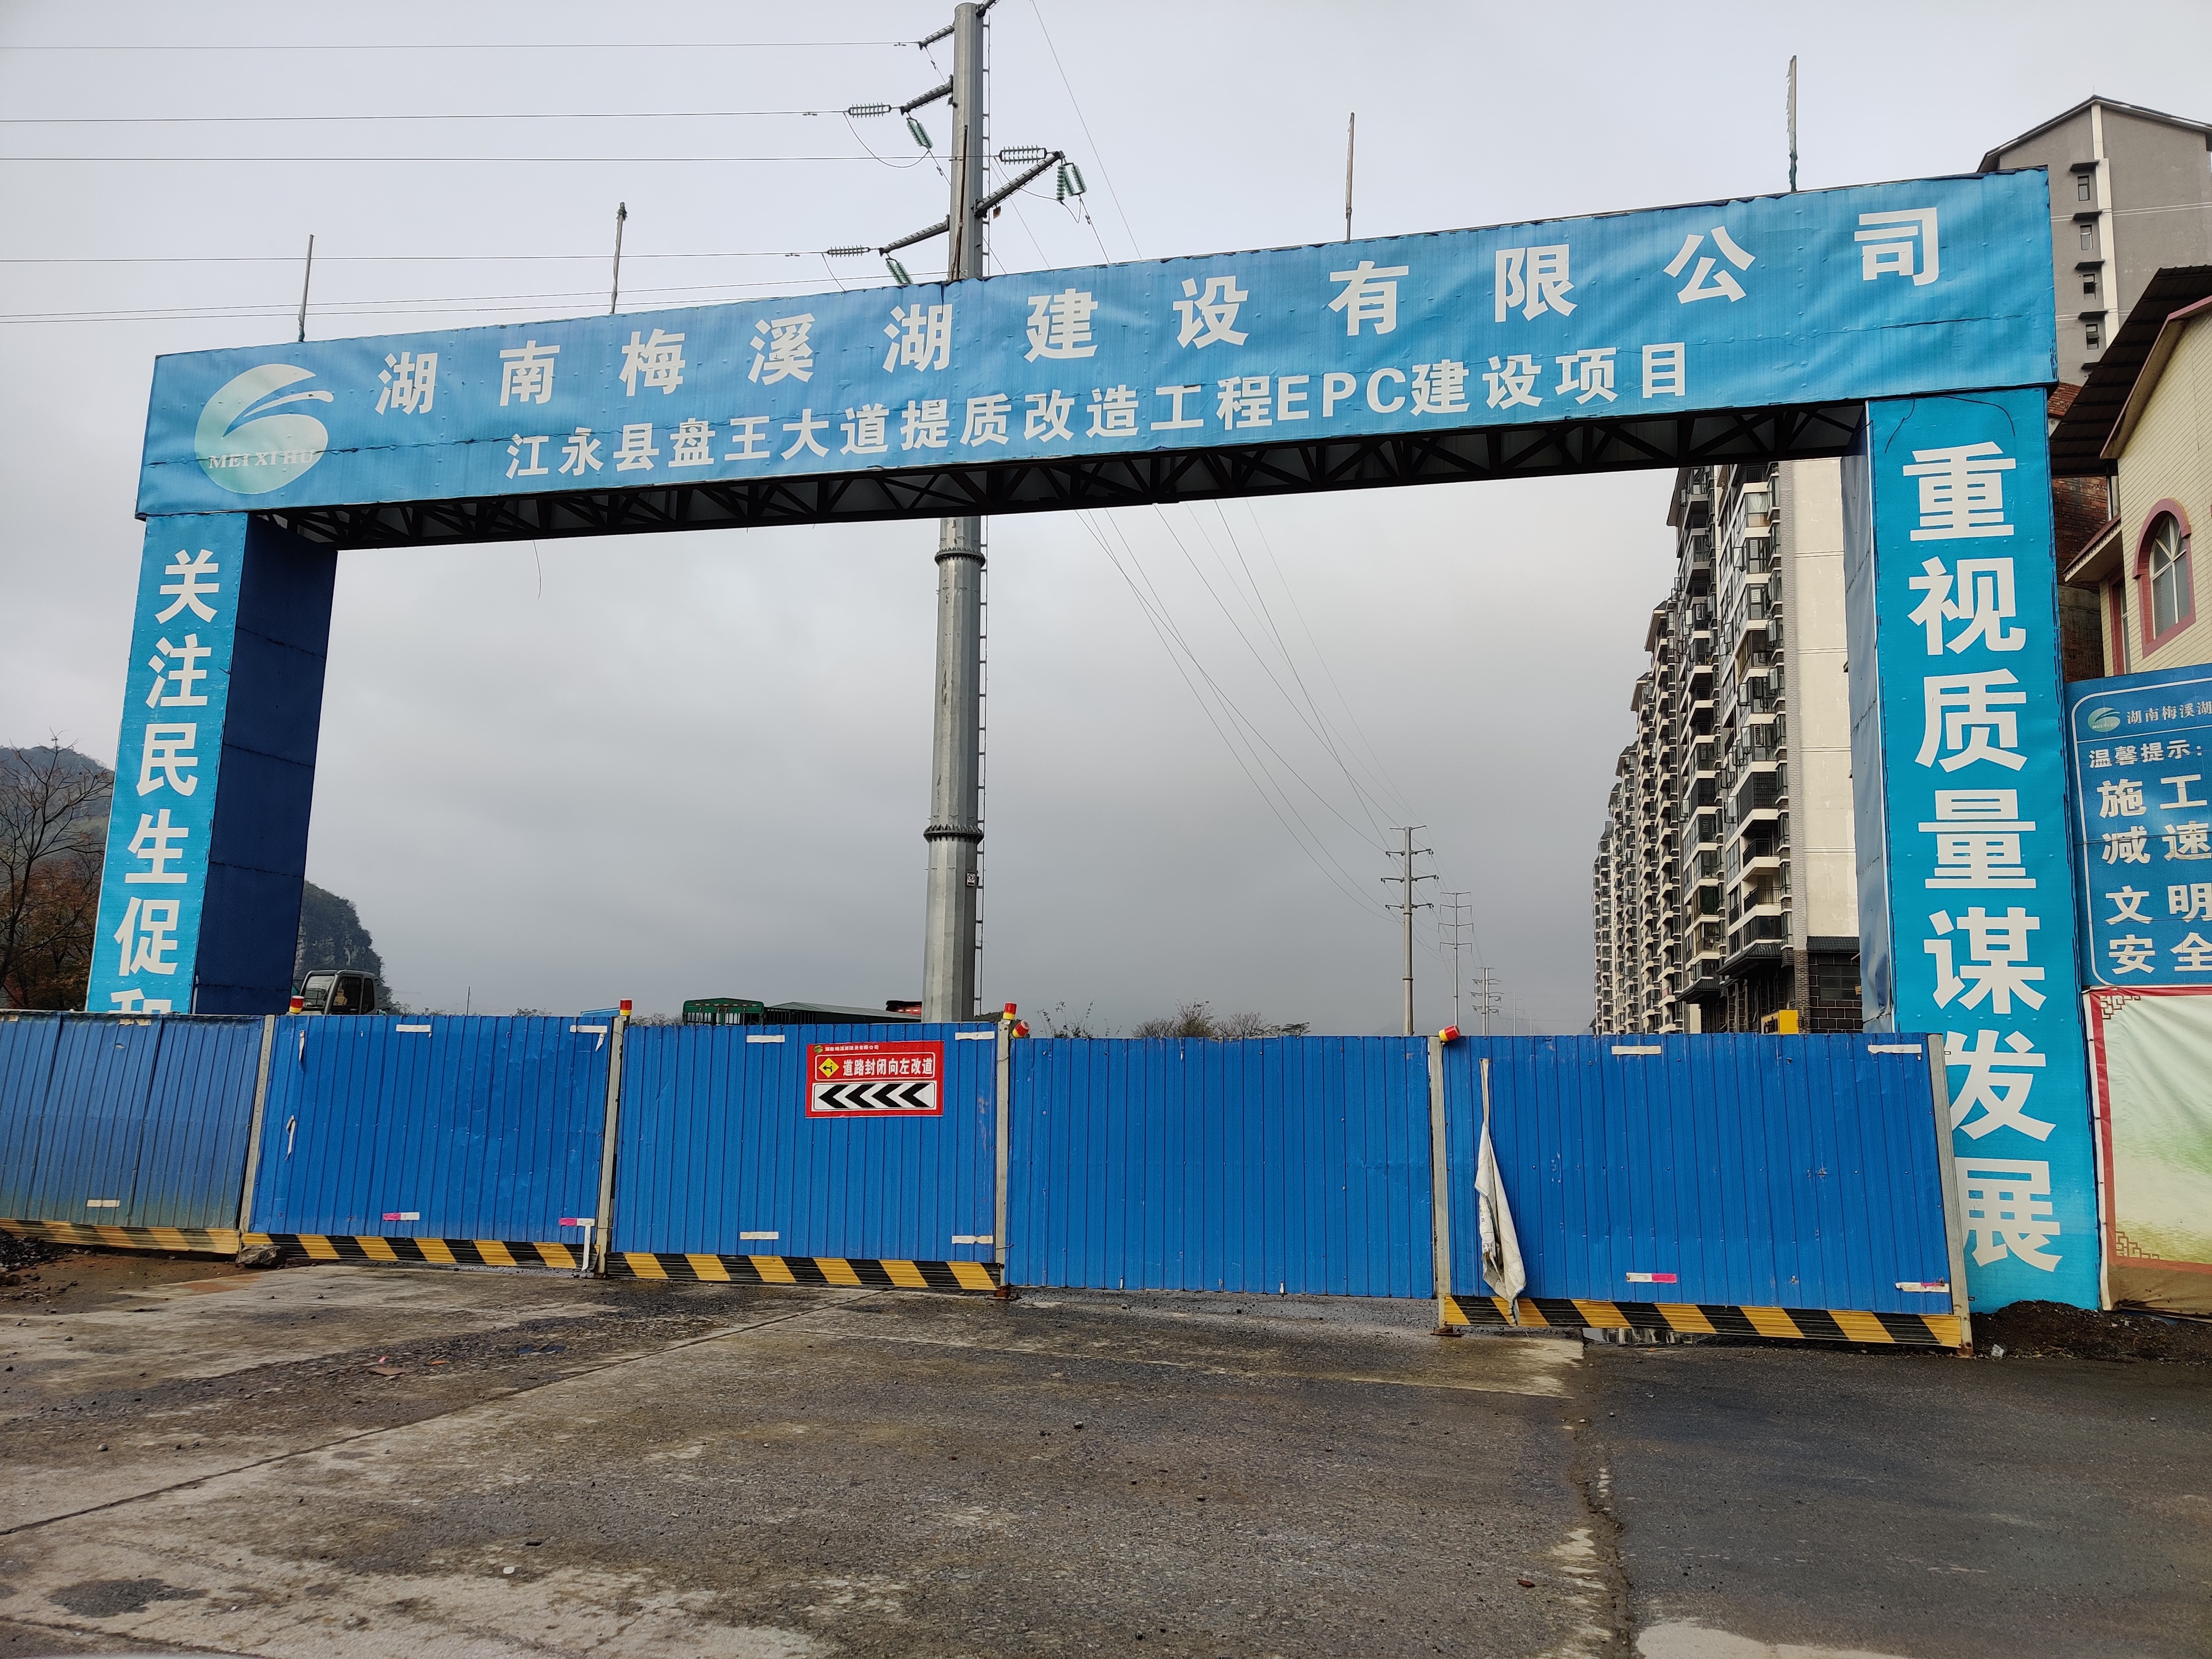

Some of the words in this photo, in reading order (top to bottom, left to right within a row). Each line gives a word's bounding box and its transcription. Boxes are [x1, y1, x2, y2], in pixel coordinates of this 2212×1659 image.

[375, 207, 1939, 415] 湖南梅溪湖建设有限公司
[505, 342, 1686, 479] 江永县盘王大道提质改造工程EPC建设项目
[208, 453, 251, 468] MEI
[2126, 701, 2212, 724] 湖南梅溪湖
[2096, 774, 2208, 818] 施工
[1903, 442, 2062, 1272] 重视质量谋发展
[2101, 820, 2212, 865] 减速
[2105, 883, 2212, 926] 文明
[2108, 931, 2212, 975] 安全
[843, 1058, 933, 1076] 道路封闭向左改道
